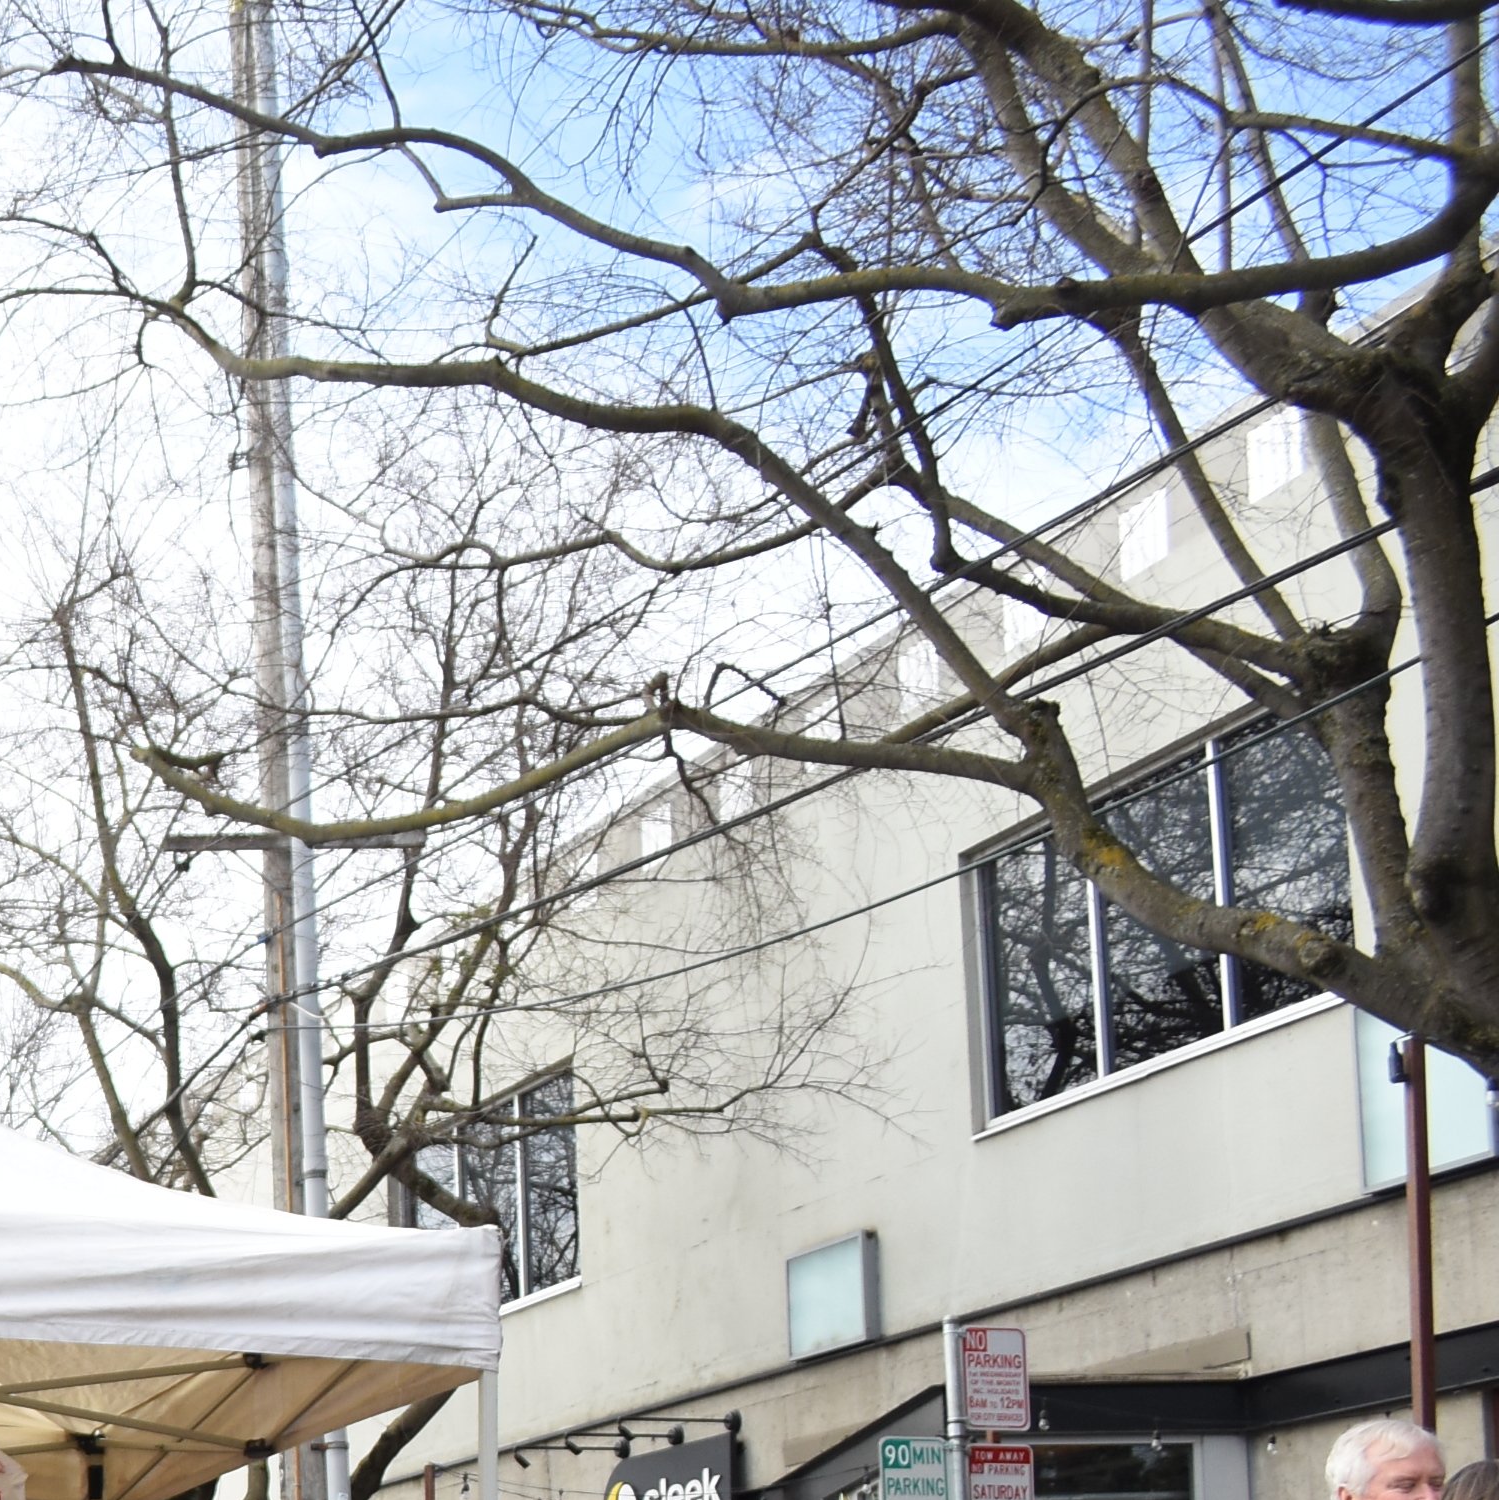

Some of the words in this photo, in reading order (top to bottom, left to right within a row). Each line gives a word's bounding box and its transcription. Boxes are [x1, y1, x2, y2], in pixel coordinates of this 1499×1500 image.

[966, 1331, 986, 1350] NO
[967, 1353, 1022, 1369] PARKING
[969, 1395, 987, 1408] 8AM
[1000, 1396, 1025, 1409] 12PM
[885, 1444, 910, 1466] 90
[912, 1446, 943, 1465] MIN
[974, 1451, 993, 1460] TOW
[998, 1451, 1025, 1460] AWAY
[988, 1464, 1026, 1476] PARKING
[886, 1477, 945, 1497] PARKING
[973, 1484, 1028, 1500] SATURDAY
